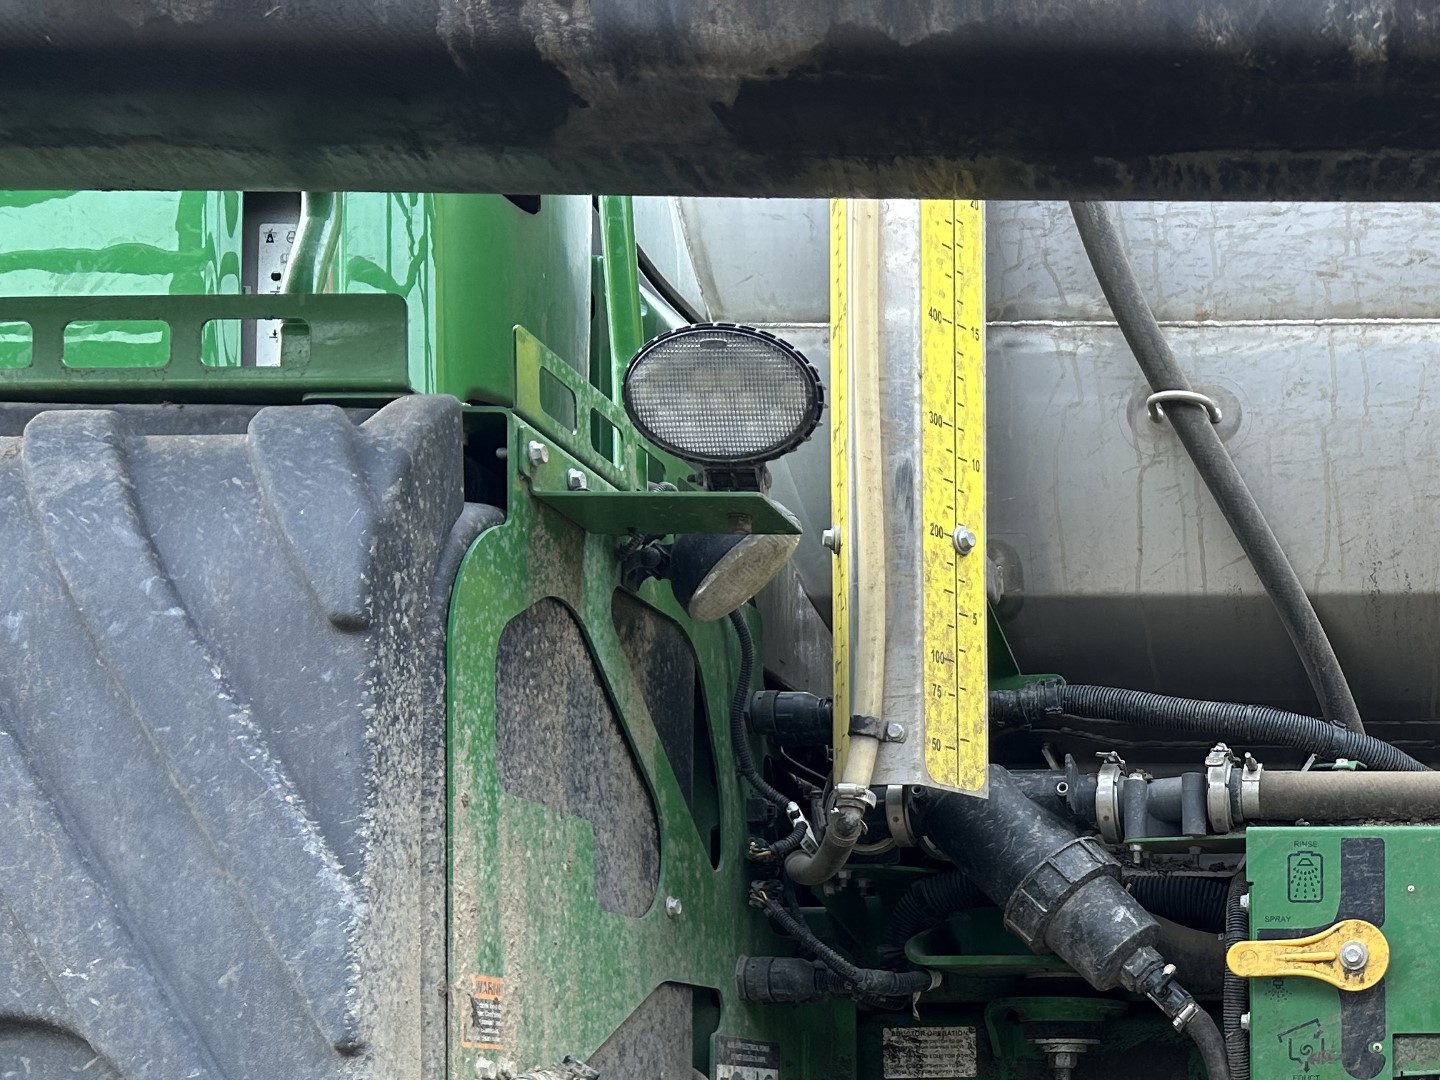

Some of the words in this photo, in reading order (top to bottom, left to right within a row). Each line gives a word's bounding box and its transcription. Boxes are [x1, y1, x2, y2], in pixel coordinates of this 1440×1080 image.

[928, 308, 943, 325] 400
[970, 327, 981, 342] 15
[928, 411, 943, 428] 300
[971, 458, 981, 473] 10
[929, 523, 944, 540] 200
[972, 612, 979, 627] 5
[930, 649, 945, 665] 100
[932, 684, 943, 699] 75
[931, 737, 942, 752] 50
[1292, 839, 1320, 849] RINSE
[1264, 915, 1292, 924] SPRAY
